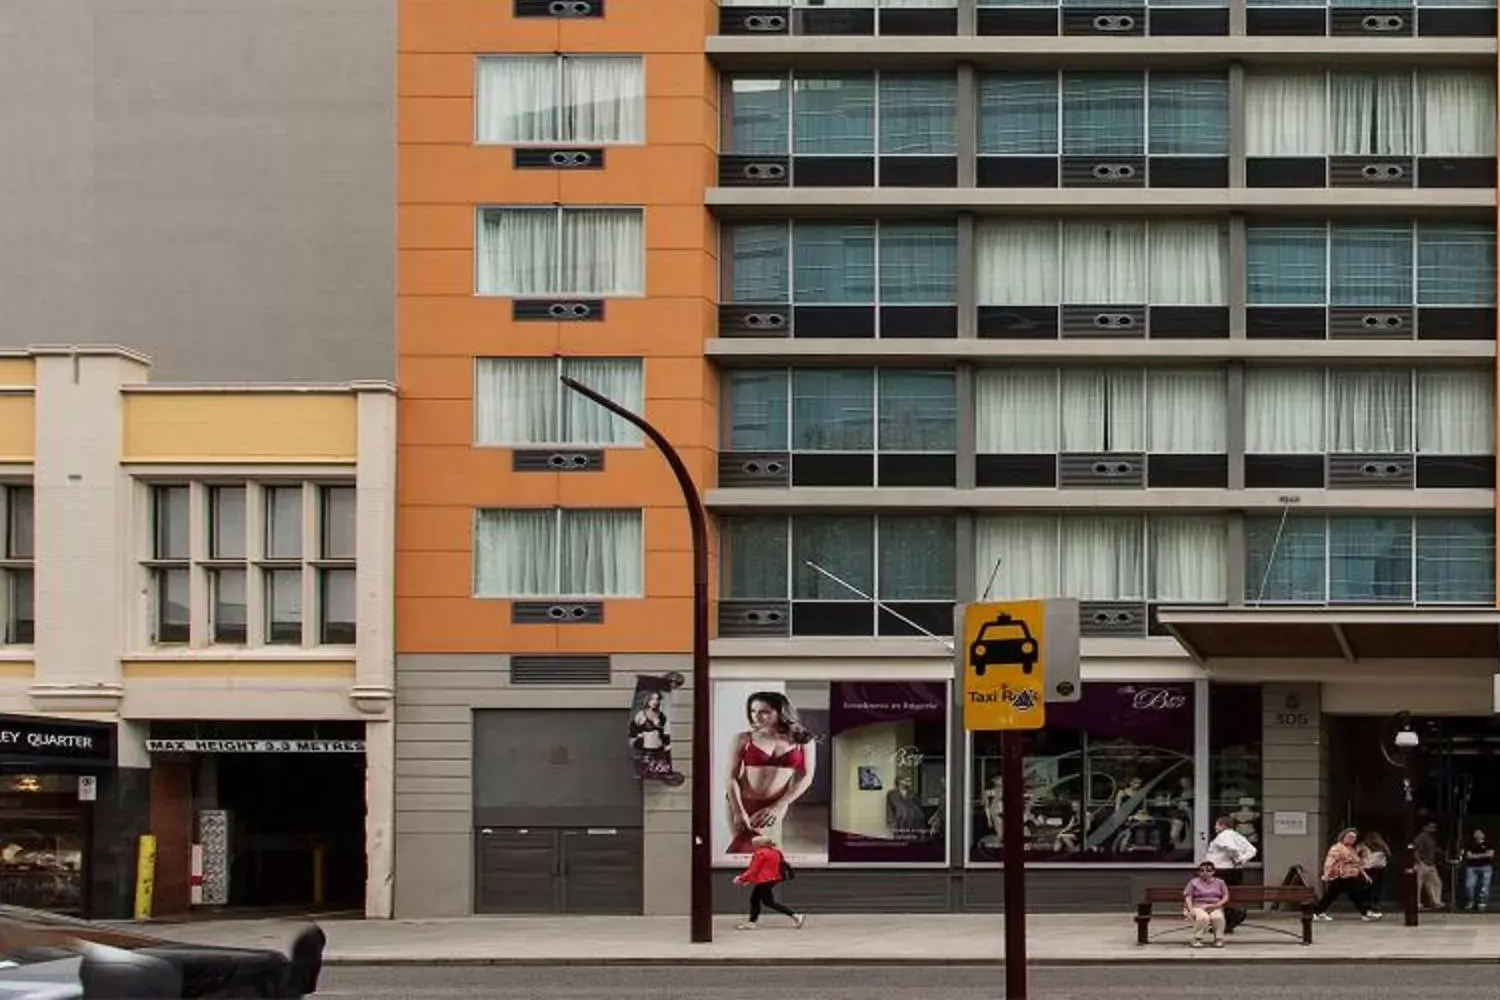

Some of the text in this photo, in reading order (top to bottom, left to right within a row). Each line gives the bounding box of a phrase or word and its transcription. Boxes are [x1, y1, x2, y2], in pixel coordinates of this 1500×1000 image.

[968, 690, 997, 703] Taxi
[0, 731, 94, 748] EY QUARTER
[150, 741, 185, 750] MAX
[196, 741, 258, 751] HEIGHT
[297, 742, 365, 751] METRES
